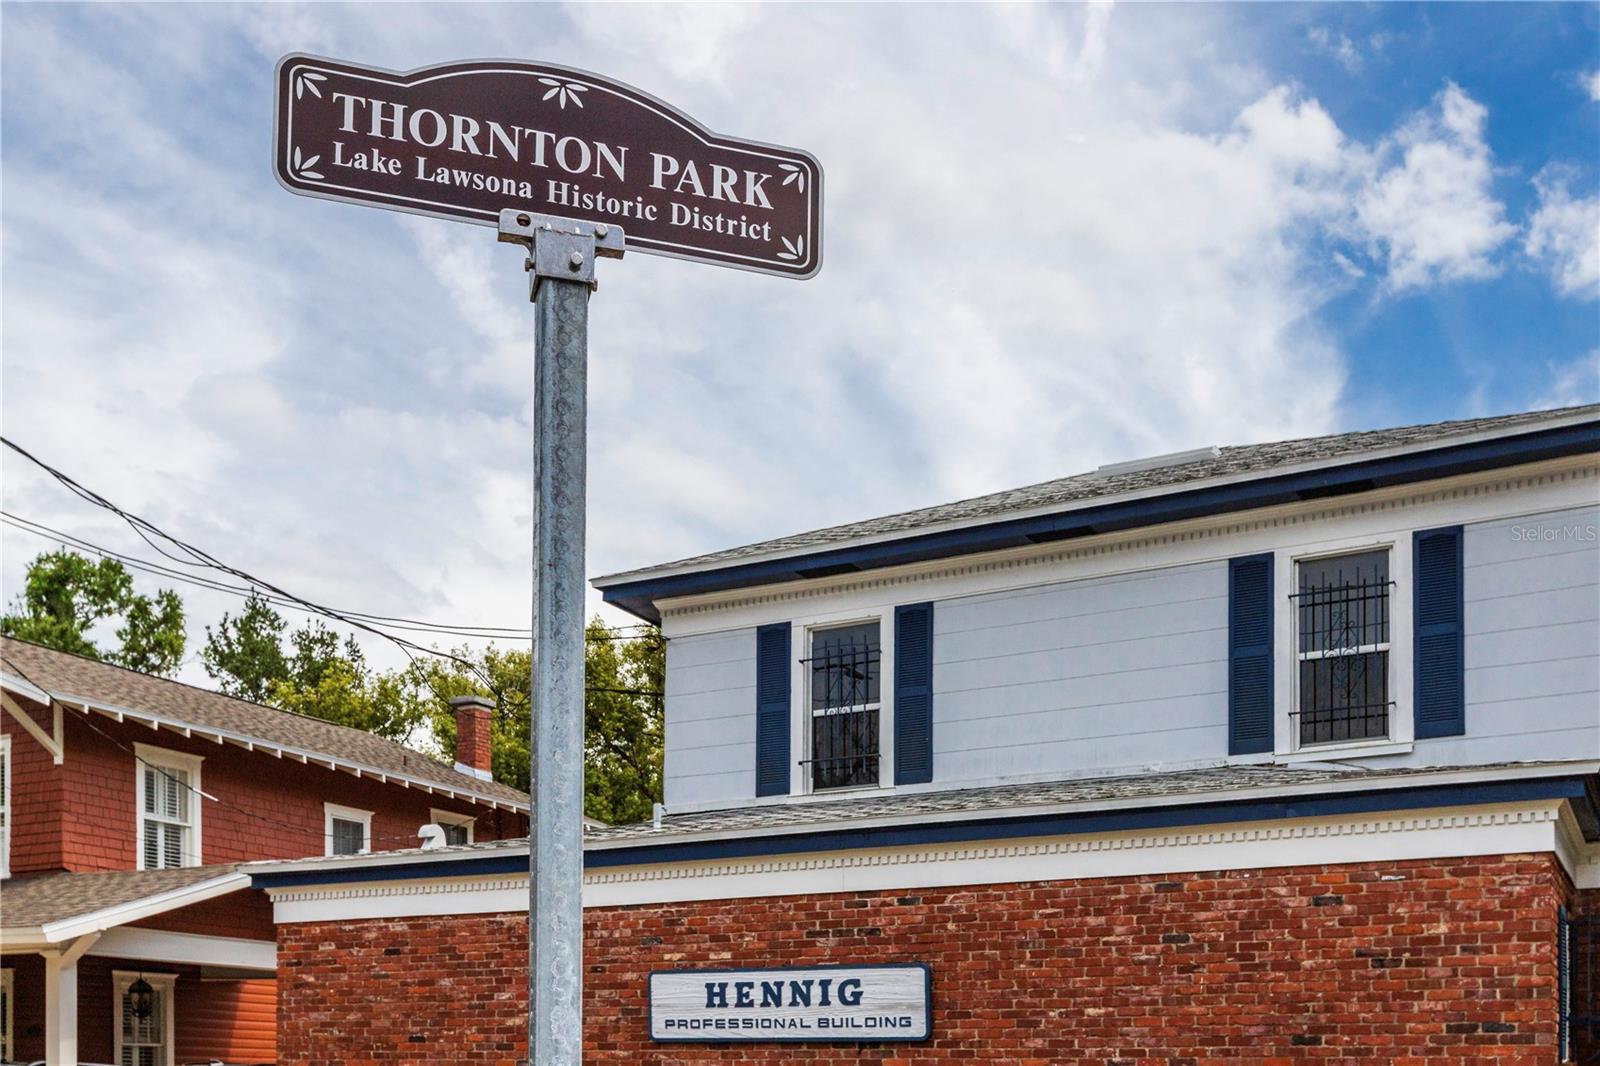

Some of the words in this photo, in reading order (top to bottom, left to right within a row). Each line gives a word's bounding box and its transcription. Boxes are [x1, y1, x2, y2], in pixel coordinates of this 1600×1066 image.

[332, 91, 628, 182] THORNTON
[650, 152, 775, 210] PARK
[332, 141, 402, 176] Lake
[415, 156, 533, 199] Lawsona
[546, 179, 658, 222] Historic
[670, 203, 772, 242] District
[665, 1017, 812, 1030] PROFESSIONAL
[817, 1016, 912, 1029] BUILDING
[704, 978, 864, 1009] HENNIG
